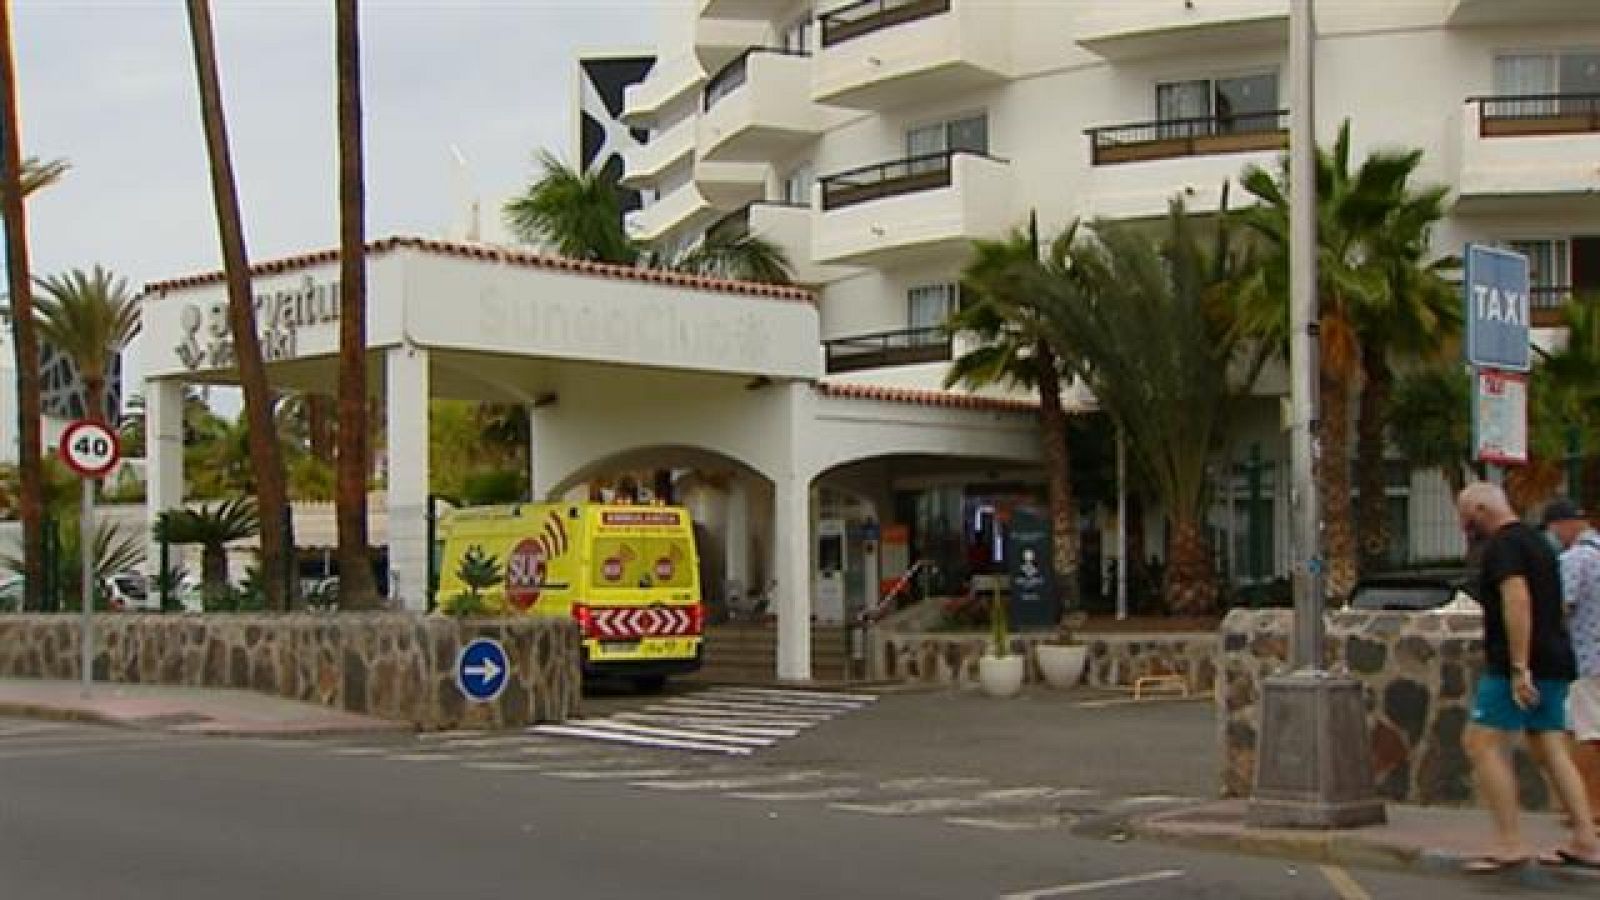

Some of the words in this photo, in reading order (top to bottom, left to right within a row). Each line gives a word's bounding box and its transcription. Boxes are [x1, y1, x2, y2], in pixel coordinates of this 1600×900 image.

[1474, 285, 1527, 325] TAXI
[74, 436, 108, 456] 40
[510, 554, 546, 585] SUC
